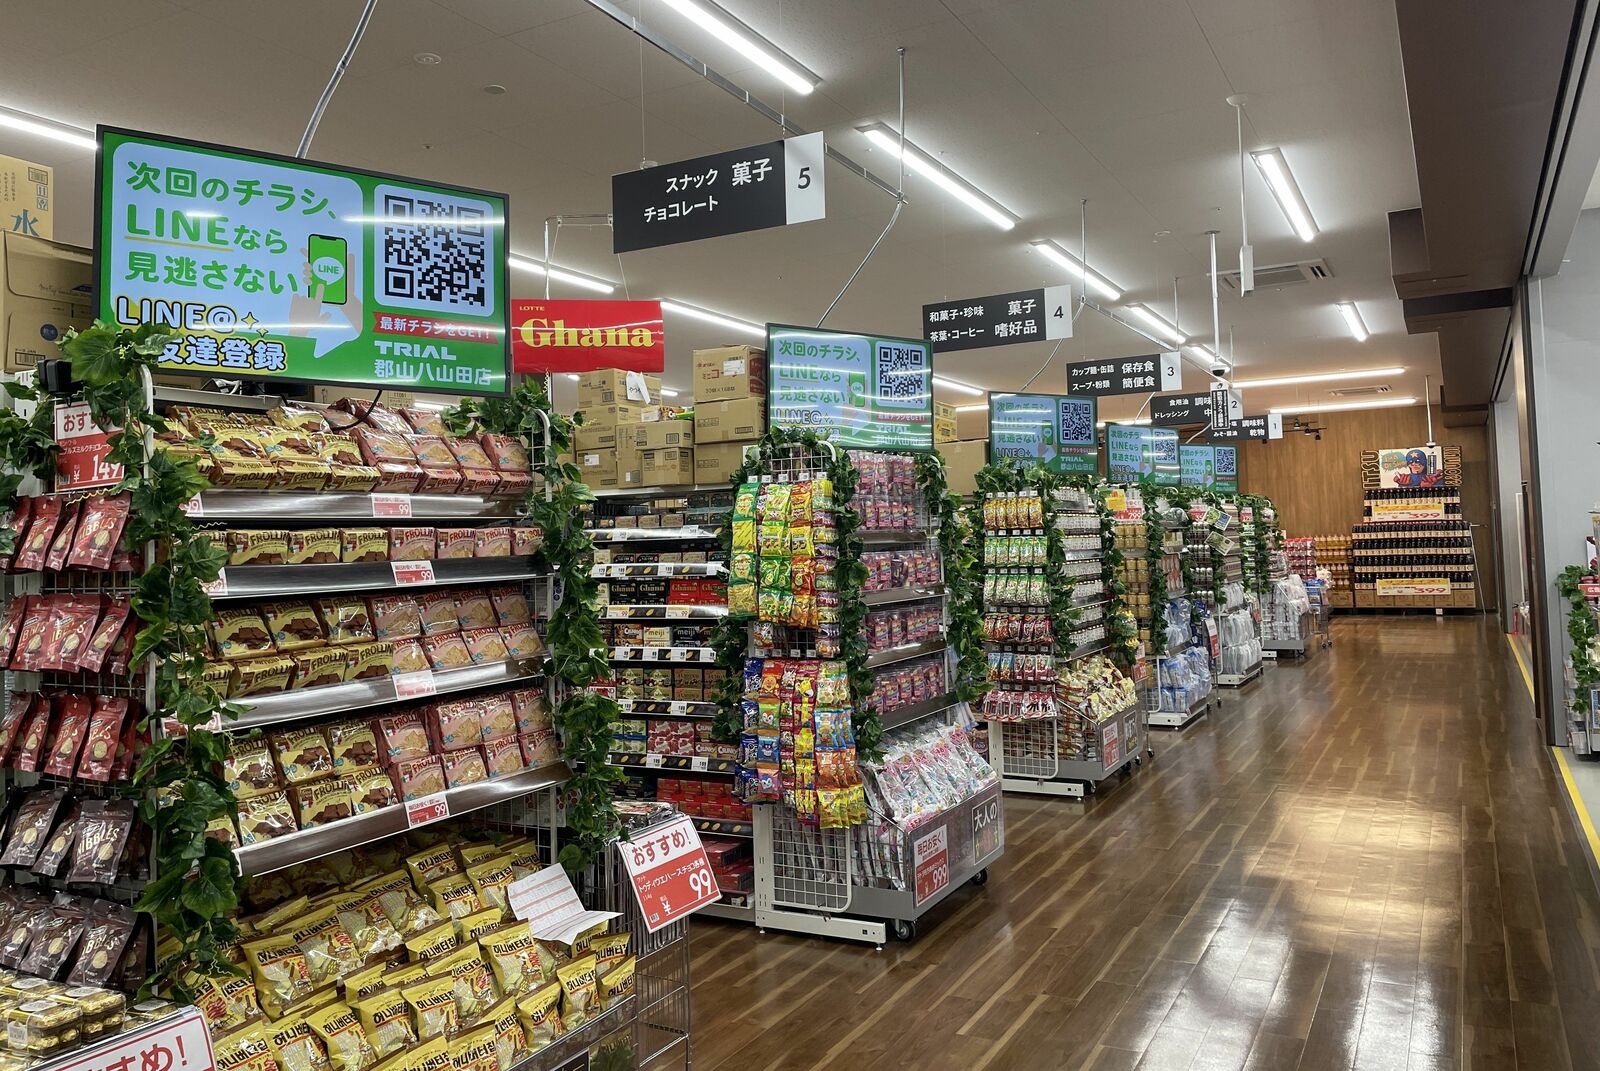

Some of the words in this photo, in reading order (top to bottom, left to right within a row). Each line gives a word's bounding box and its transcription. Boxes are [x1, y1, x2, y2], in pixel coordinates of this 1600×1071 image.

[666, 168, 719, 194] スナック
[732, 157, 773, 187] 菓子
[797, 166, 811, 190] 5
[126, 160, 336, 220] 次回のチラシ、
[643, 195, 719, 223] チョコレート
[10, 208, 40, 237] 水
[126, 203, 288, 255] LINEなら
[125, 250, 298, 296] 見逃さない
[318, 263, 339, 276] LINE
[929, 305, 984, 323] 和菓子・珍味
[1007, 299, 1037, 316] 菓子
[1053, 305, 1064, 319] 4
[520, 318, 656, 348] Ghana
[929, 327, 985, 342] 茶葉・コーヒー
[994, 319, 1037, 338] 嗜好品
[374, 340, 457, 361] TRIAL
[779, 340, 861, 362] 次回のチラシ、
[374, 359, 492, 386] 郡山八山田店
[1121, 360, 1154, 374] 保存食
[1167, 366, 1175, 377] 3
[1154, 409, 1189, 419] ドレッシング
[1231, 400, 1237, 409] 2
[399, 504, 410, 514] 99
[420, 570, 432, 581] 99
[611, 582, 636, 593] Ghana
[640, 582, 665, 593] Ghana
[671, 583, 698, 592] Ghana
[648, 629, 665, 639] meiji
[677, 628, 696, 639] meiji
[434, 804, 446, 817] 99
[974, 802, 997, 832] 大人の
[632, 827, 691, 867] おすすめ!
[689, 868, 711, 900] 99
[933, 863, 946, 889] 999
[493, 934, 532, 954] 허니버터칩
[86, 1034, 188, 1071] すめ!
